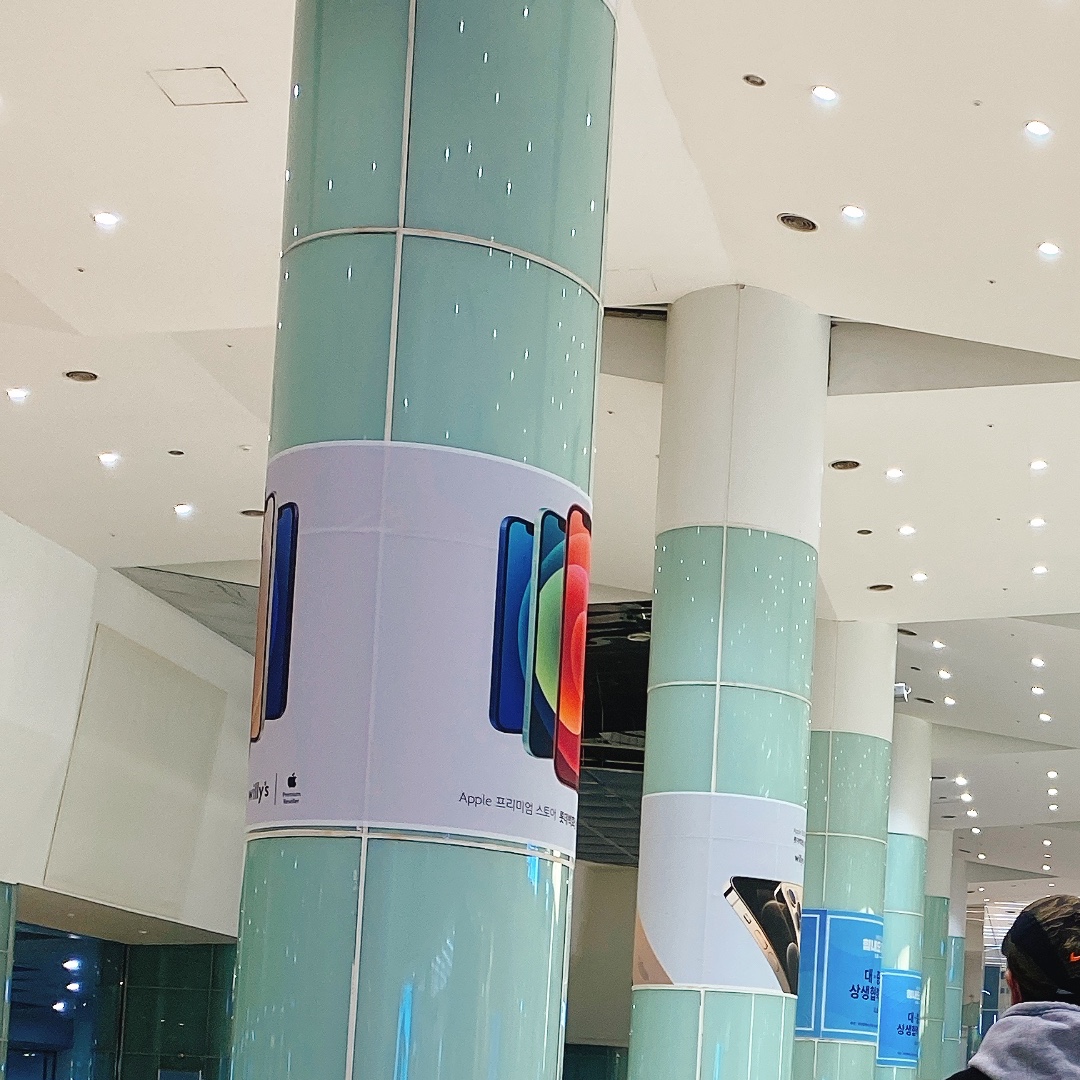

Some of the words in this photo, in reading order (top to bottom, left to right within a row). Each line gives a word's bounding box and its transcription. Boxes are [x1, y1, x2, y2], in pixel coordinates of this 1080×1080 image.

[458, 791, 493, 808] Apple
[495, 796, 534, 816] 프리미엄
[535, 804, 557, 821] 스토어
